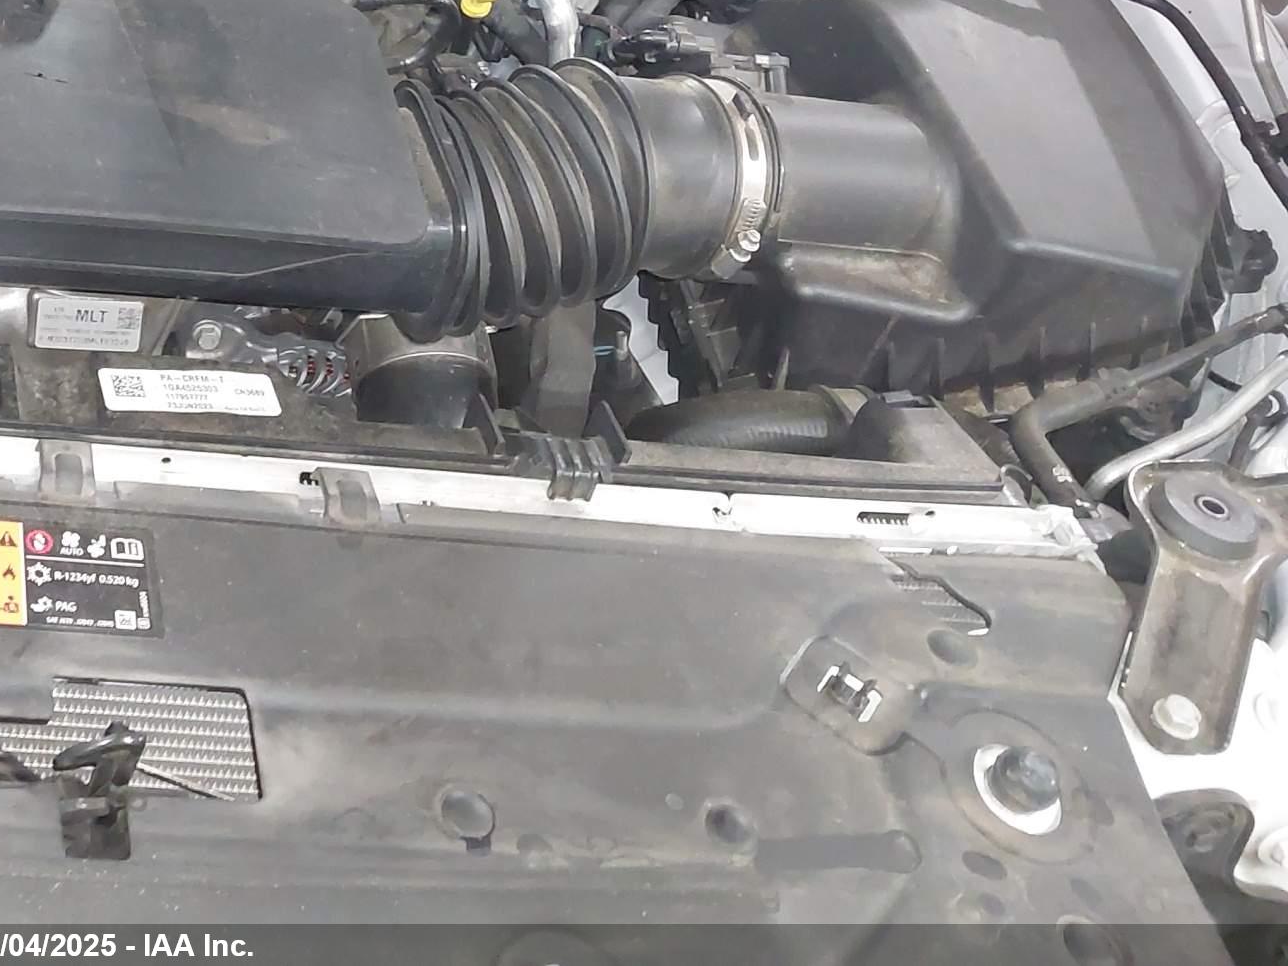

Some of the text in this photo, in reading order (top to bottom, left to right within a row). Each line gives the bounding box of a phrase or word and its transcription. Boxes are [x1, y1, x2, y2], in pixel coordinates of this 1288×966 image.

[74, 309, 109, 324] MLT
[59, 547, 85, 556] AUTO
[54, 600, 78, 613] PAG
